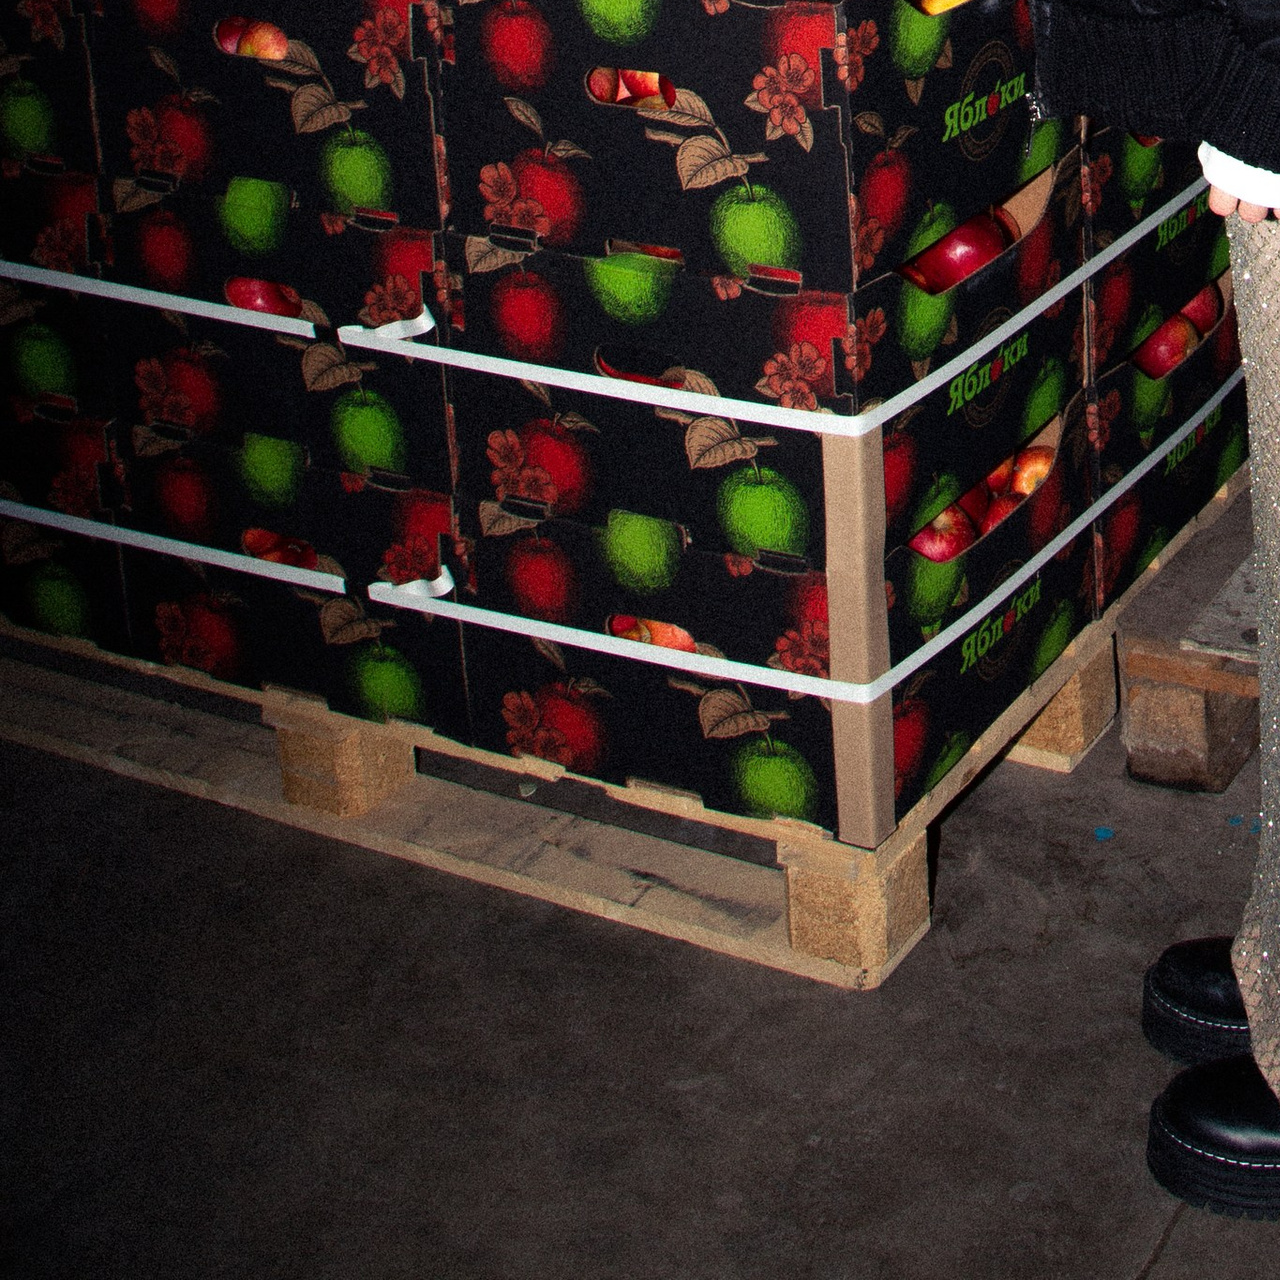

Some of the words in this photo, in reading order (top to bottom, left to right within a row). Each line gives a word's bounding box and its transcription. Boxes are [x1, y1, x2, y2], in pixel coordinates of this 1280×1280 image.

[942, 72, 1026, 143] Яблоки
[1154, 189, 1209, 252] Яблок
[946, 332, 1029, 416] Яблоки
[960, 578, 1042, 674] Яблоки
